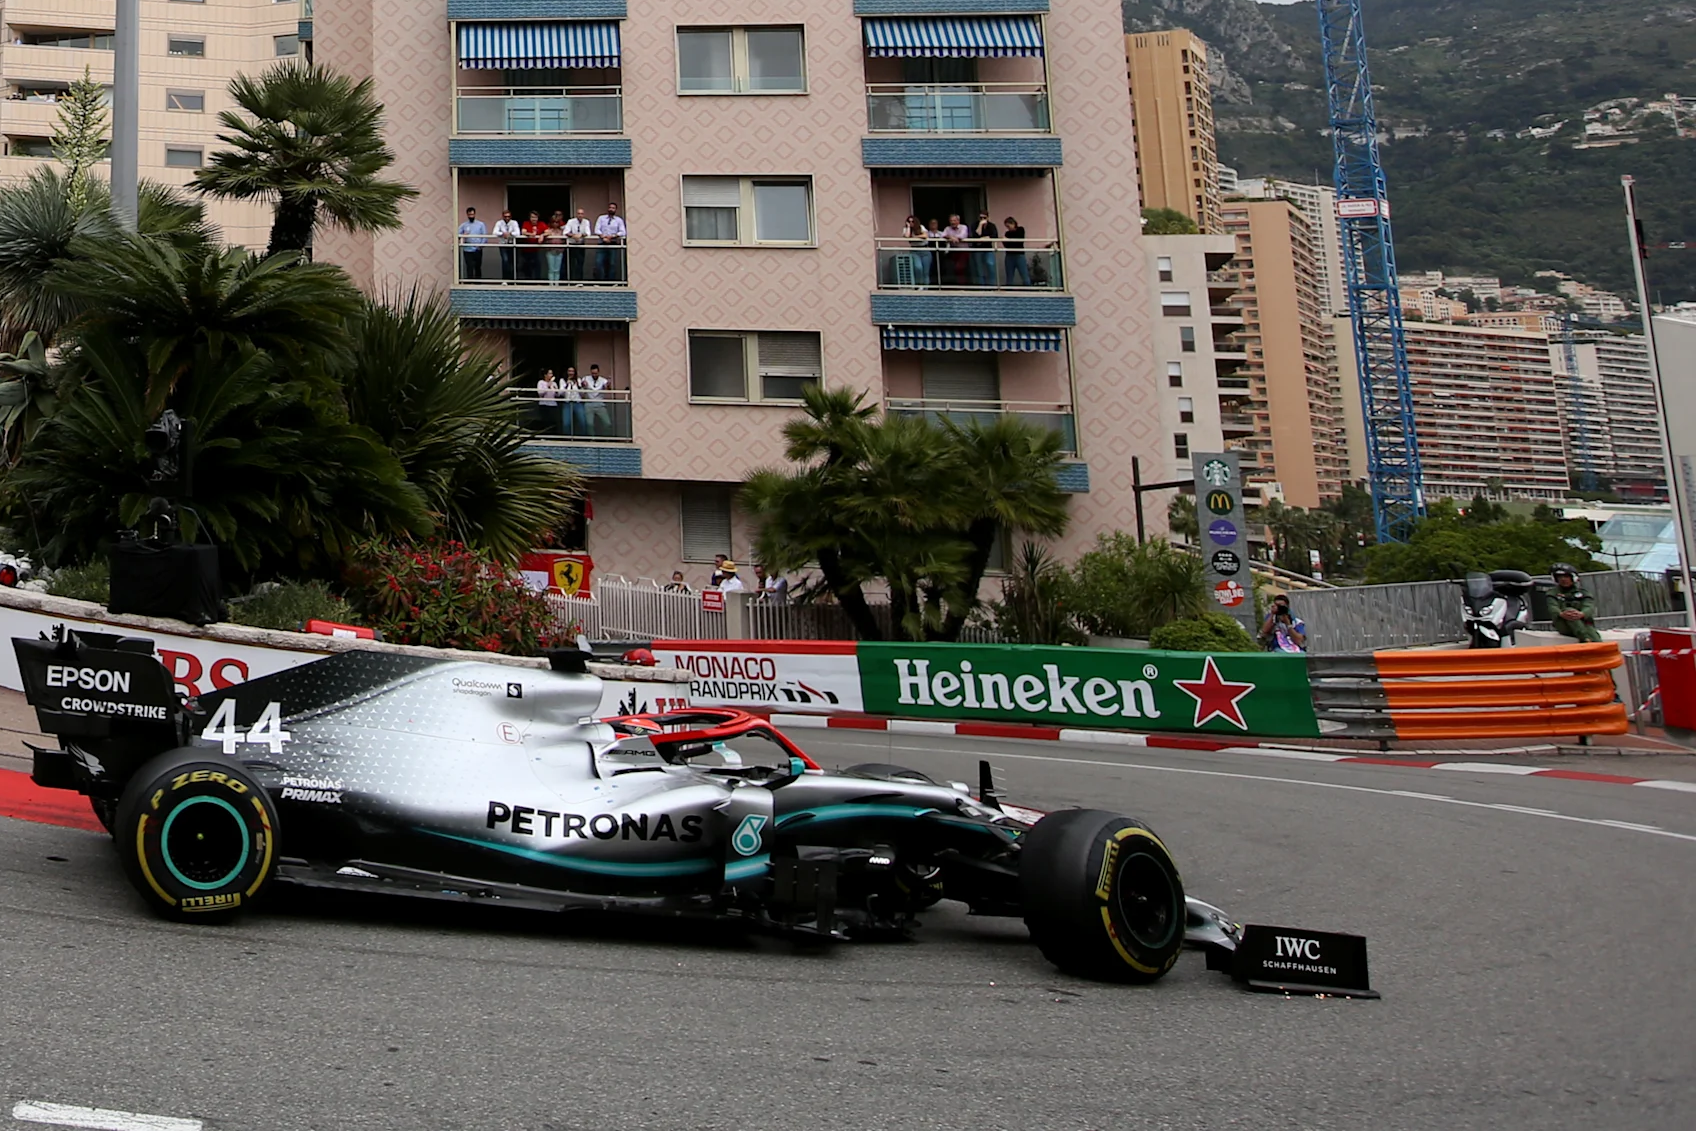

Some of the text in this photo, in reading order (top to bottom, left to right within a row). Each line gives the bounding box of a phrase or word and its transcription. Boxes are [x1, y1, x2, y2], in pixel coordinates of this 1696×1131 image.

[46, 665, 131, 693] EPSON
[674, 655, 776, 681] MONACO
[452, 678, 502, 690] Qualcomm
[893, 658, 1161, 718] Heineken
[61, 696, 167, 720] CROWDSTRIKE
[201, 698, 291, 755] 44
[624, 749, 655, 757] AMG
[151, 770, 248, 809] P ZERO
[283, 776, 342, 789] PETRONAS
[280, 787, 343, 804] PRIMAX
[486, 800, 704, 842] PETRONAS
[1095, 838, 1120, 901] PIRELLI
[182, 892, 241, 912] PIRELLI
[1275, 936, 1321, 960] IWC
[1262, 959, 1337, 975] SCHAFFHAUSEN
